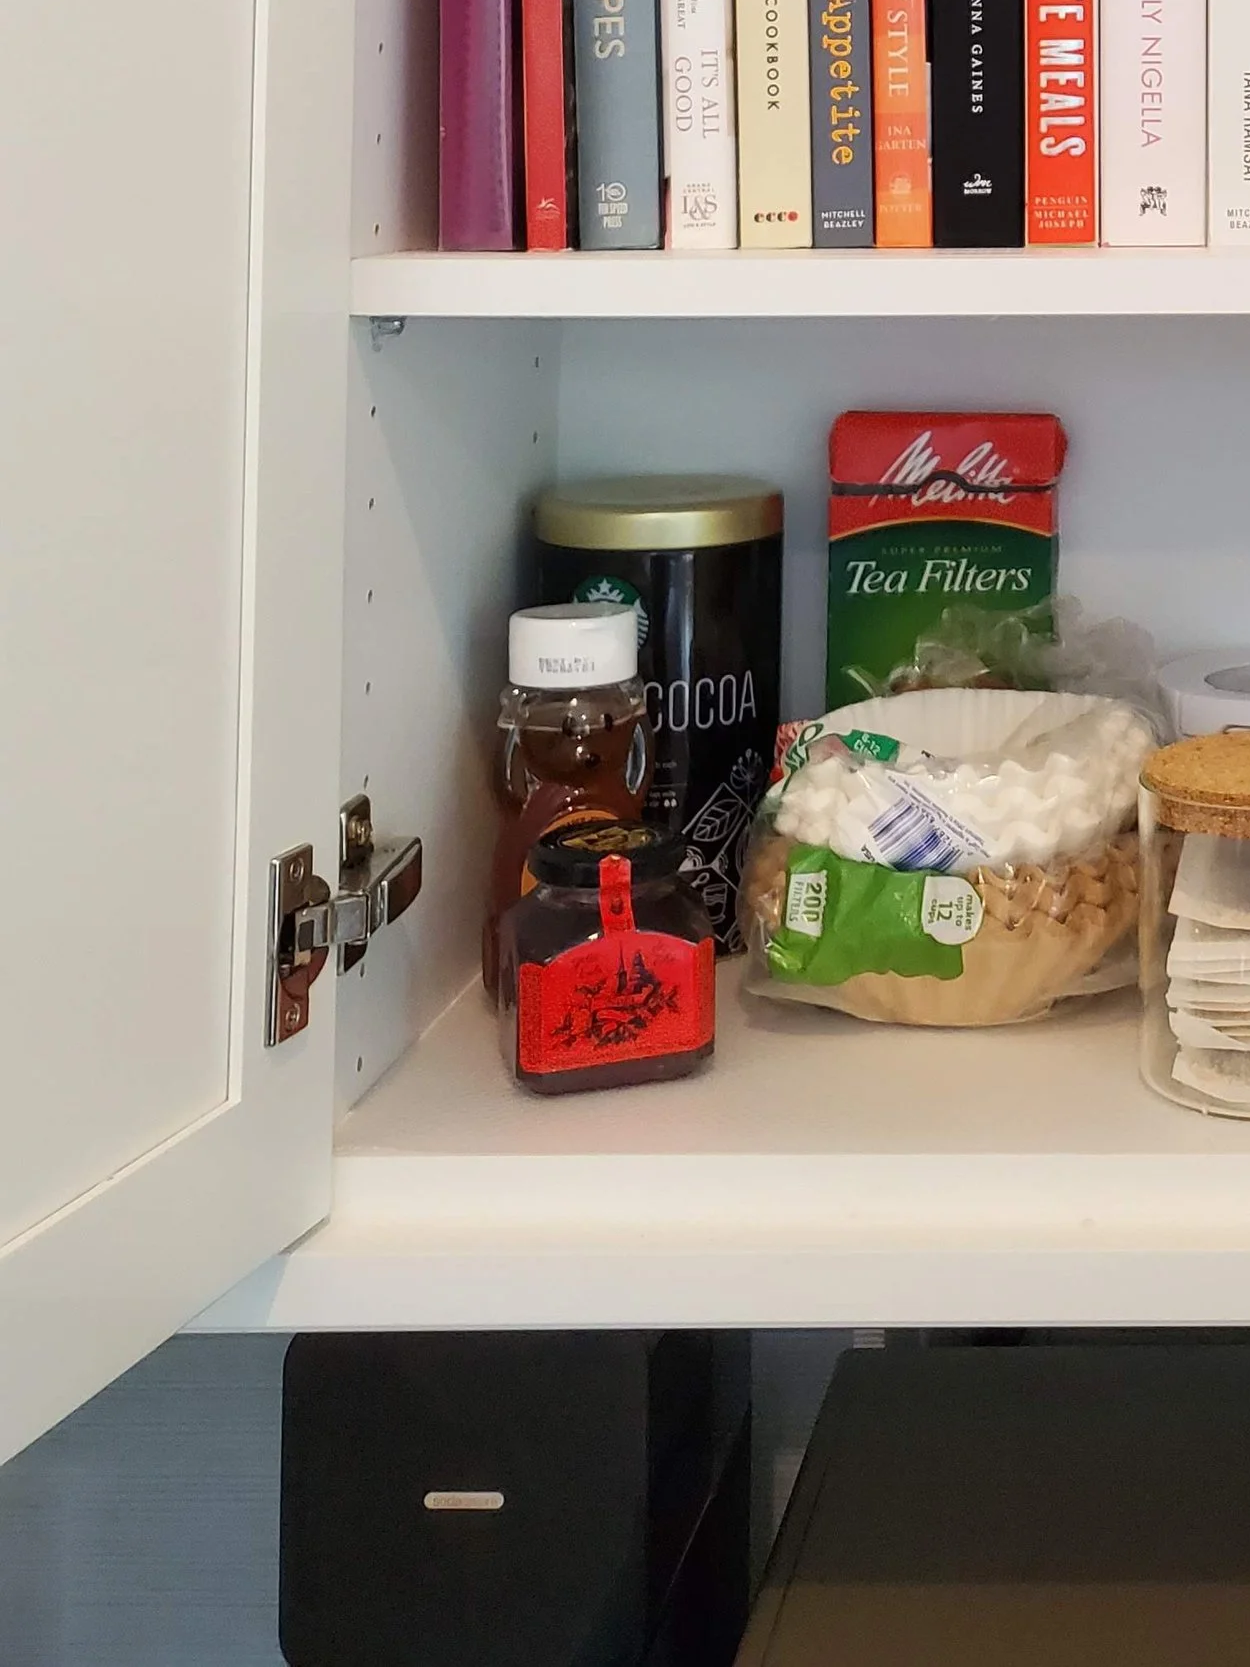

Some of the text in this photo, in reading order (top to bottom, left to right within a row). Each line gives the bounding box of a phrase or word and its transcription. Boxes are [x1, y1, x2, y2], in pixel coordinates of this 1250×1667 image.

[887, 10, 910, 98] STYLE
[674, 56, 694, 133] GOOD
[971, 44, 983, 114] GAINES
[1039, 38, 1086, 157] MEALS
[1141, 37, 1163, 148] NIGELLA
[702, 96, 721, 139] ALL
[887, 125, 912, 136] INA
[821, 209, 866, 220] MITCHELL
[822, 219, 866, 230] BEAZLEY
[846, 558, 1032, 594] Tea Filters
[643, 669, 757, 733] COCOA
[788, 881, 802, 922] FILTERS
[803, 882, 823, 923] 200
[927, 898, 938, 924] cups
[938, 901, 953, 921] 12
[955, 896, 965, 926] up to
[964, 894, 974, 931] makes
